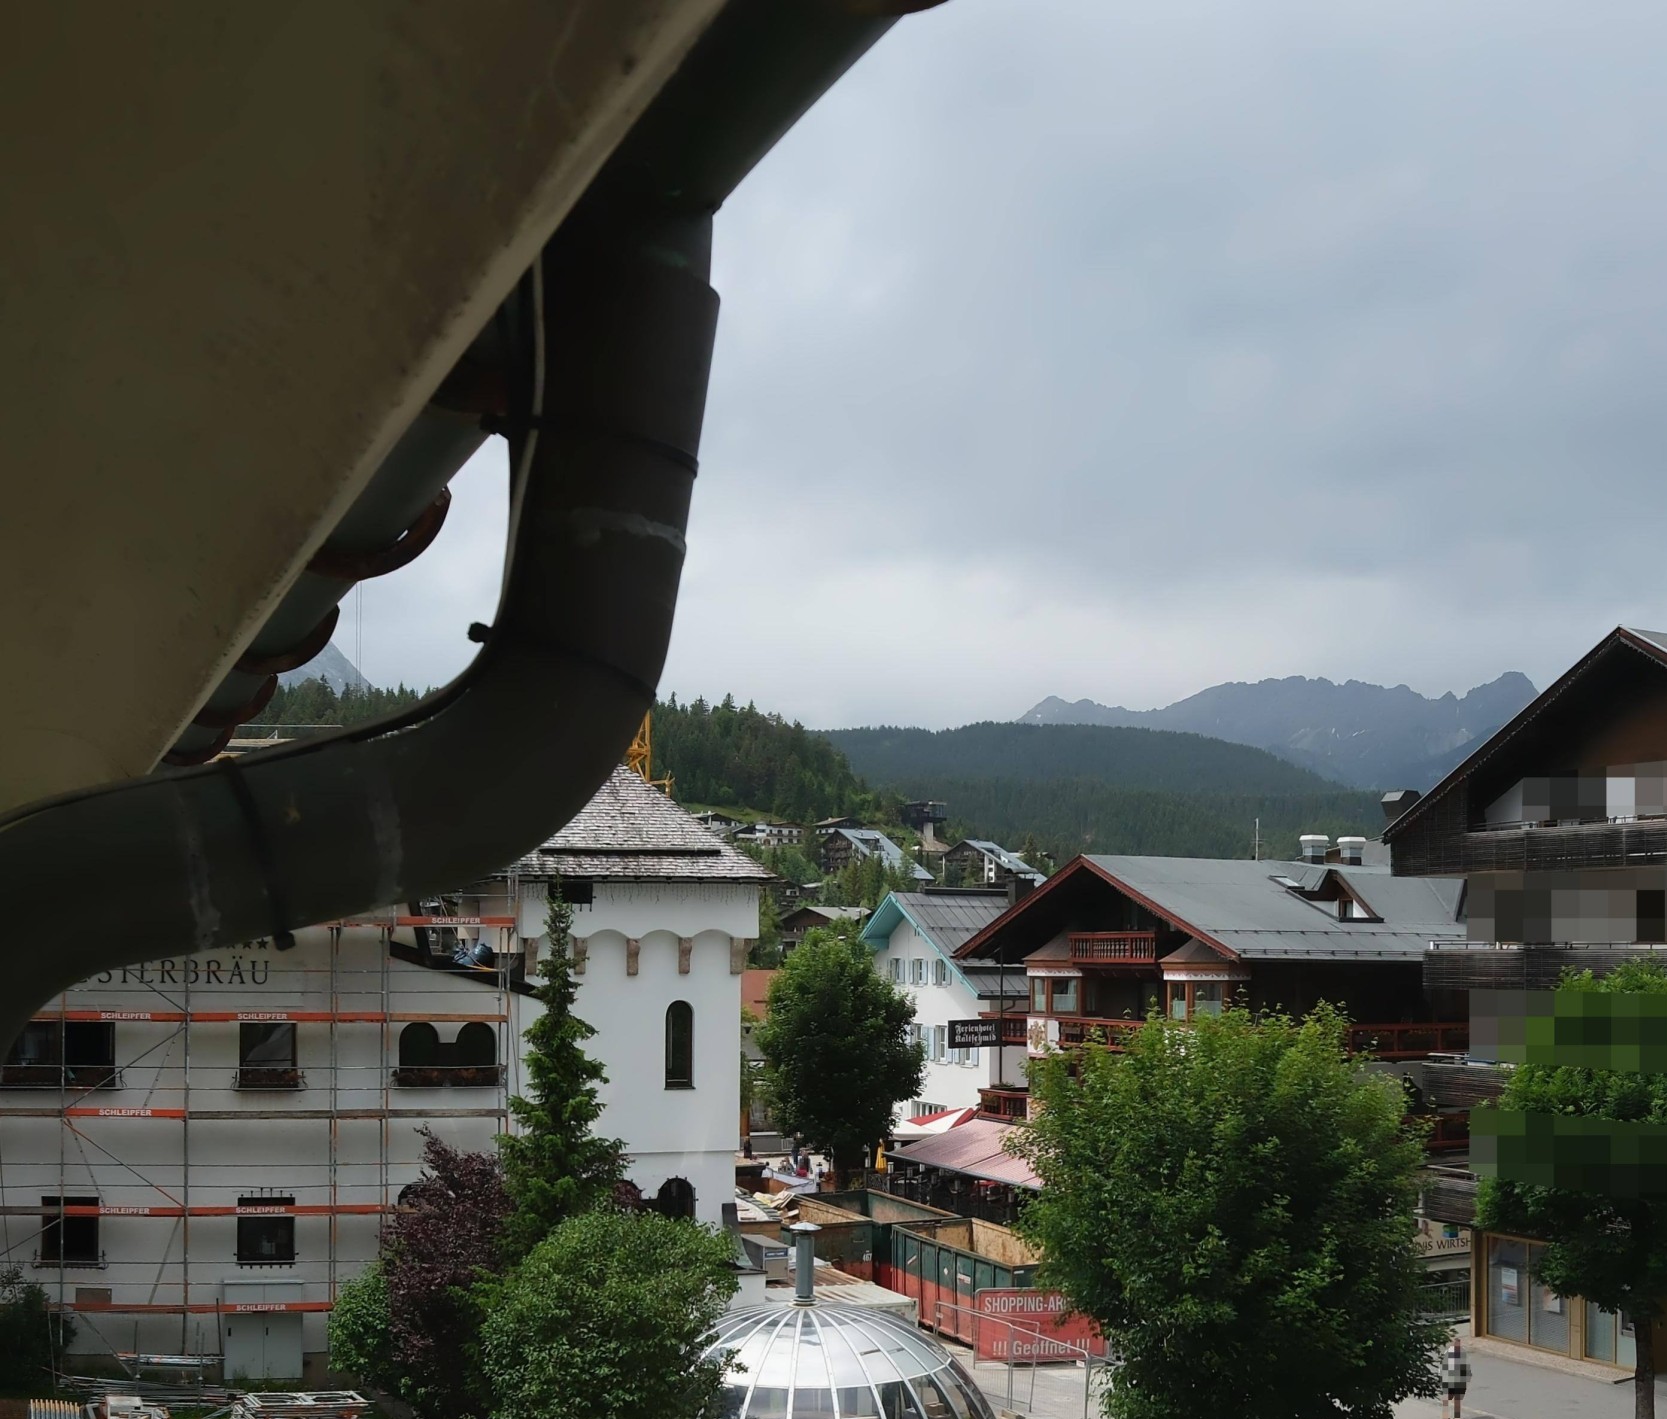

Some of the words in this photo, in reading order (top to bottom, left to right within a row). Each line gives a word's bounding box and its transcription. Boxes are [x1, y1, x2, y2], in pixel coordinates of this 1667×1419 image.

[431, 916, 481, 925] SCHLEIPFER
[100, 1012, 151, 1020] SCHLEIPFER
[237, 1012, 288, 1020] SCHLEIPFER
[98, 1108, 152, 1117] SCHLEIPFER
[99, 1207, 150, 1215] SCHLEIPFER
[235, 1206, 286, 1214] SCHLEIPFER
[235, 1303, 286, 1312] SCHLEIPFER
[1012, 1339, 1071, 1357] Geöffnet
